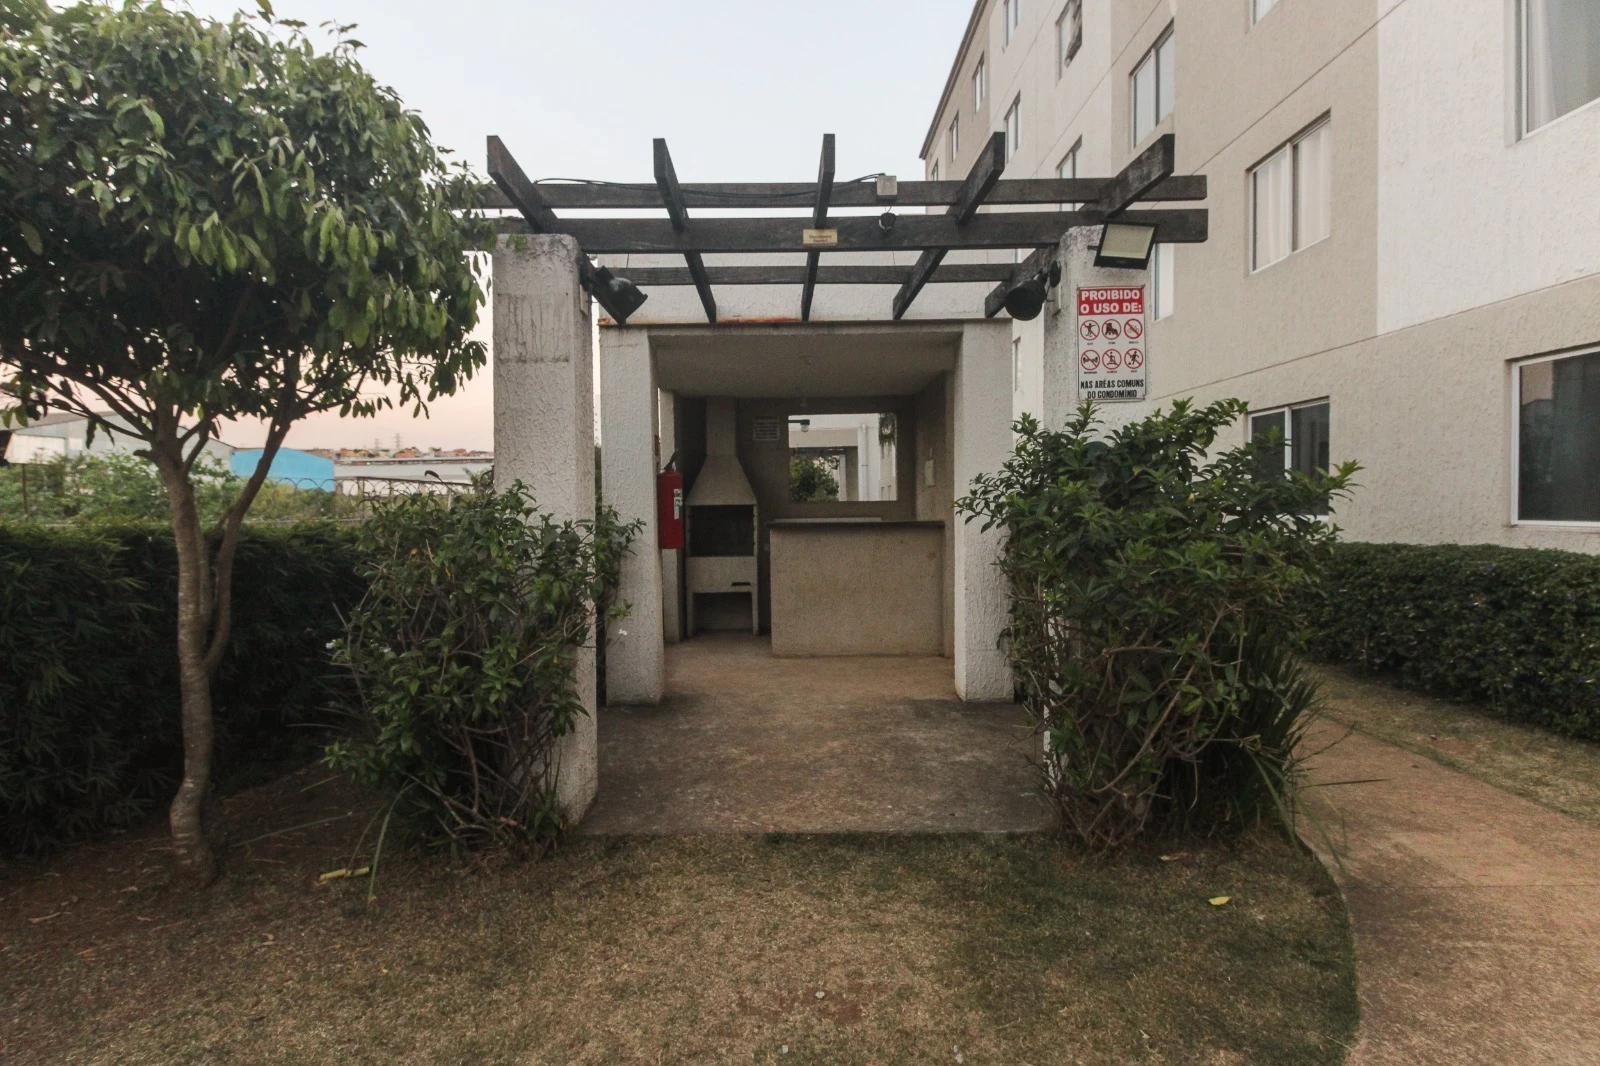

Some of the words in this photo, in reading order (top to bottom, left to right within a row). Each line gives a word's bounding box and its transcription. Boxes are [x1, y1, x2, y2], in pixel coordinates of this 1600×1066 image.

[1081, 289, 1140, 301] PROIBIDO
[1080, 303, 1090, 314] O
[1093, 302, 1120, 313] USO
[1122, 302, 1142, 313] DE:
[1081, 380, 1093, 389] NAS
[1117, 379, 1144, 388] COMUNS
[1087, 391, 1096, 399] DO
